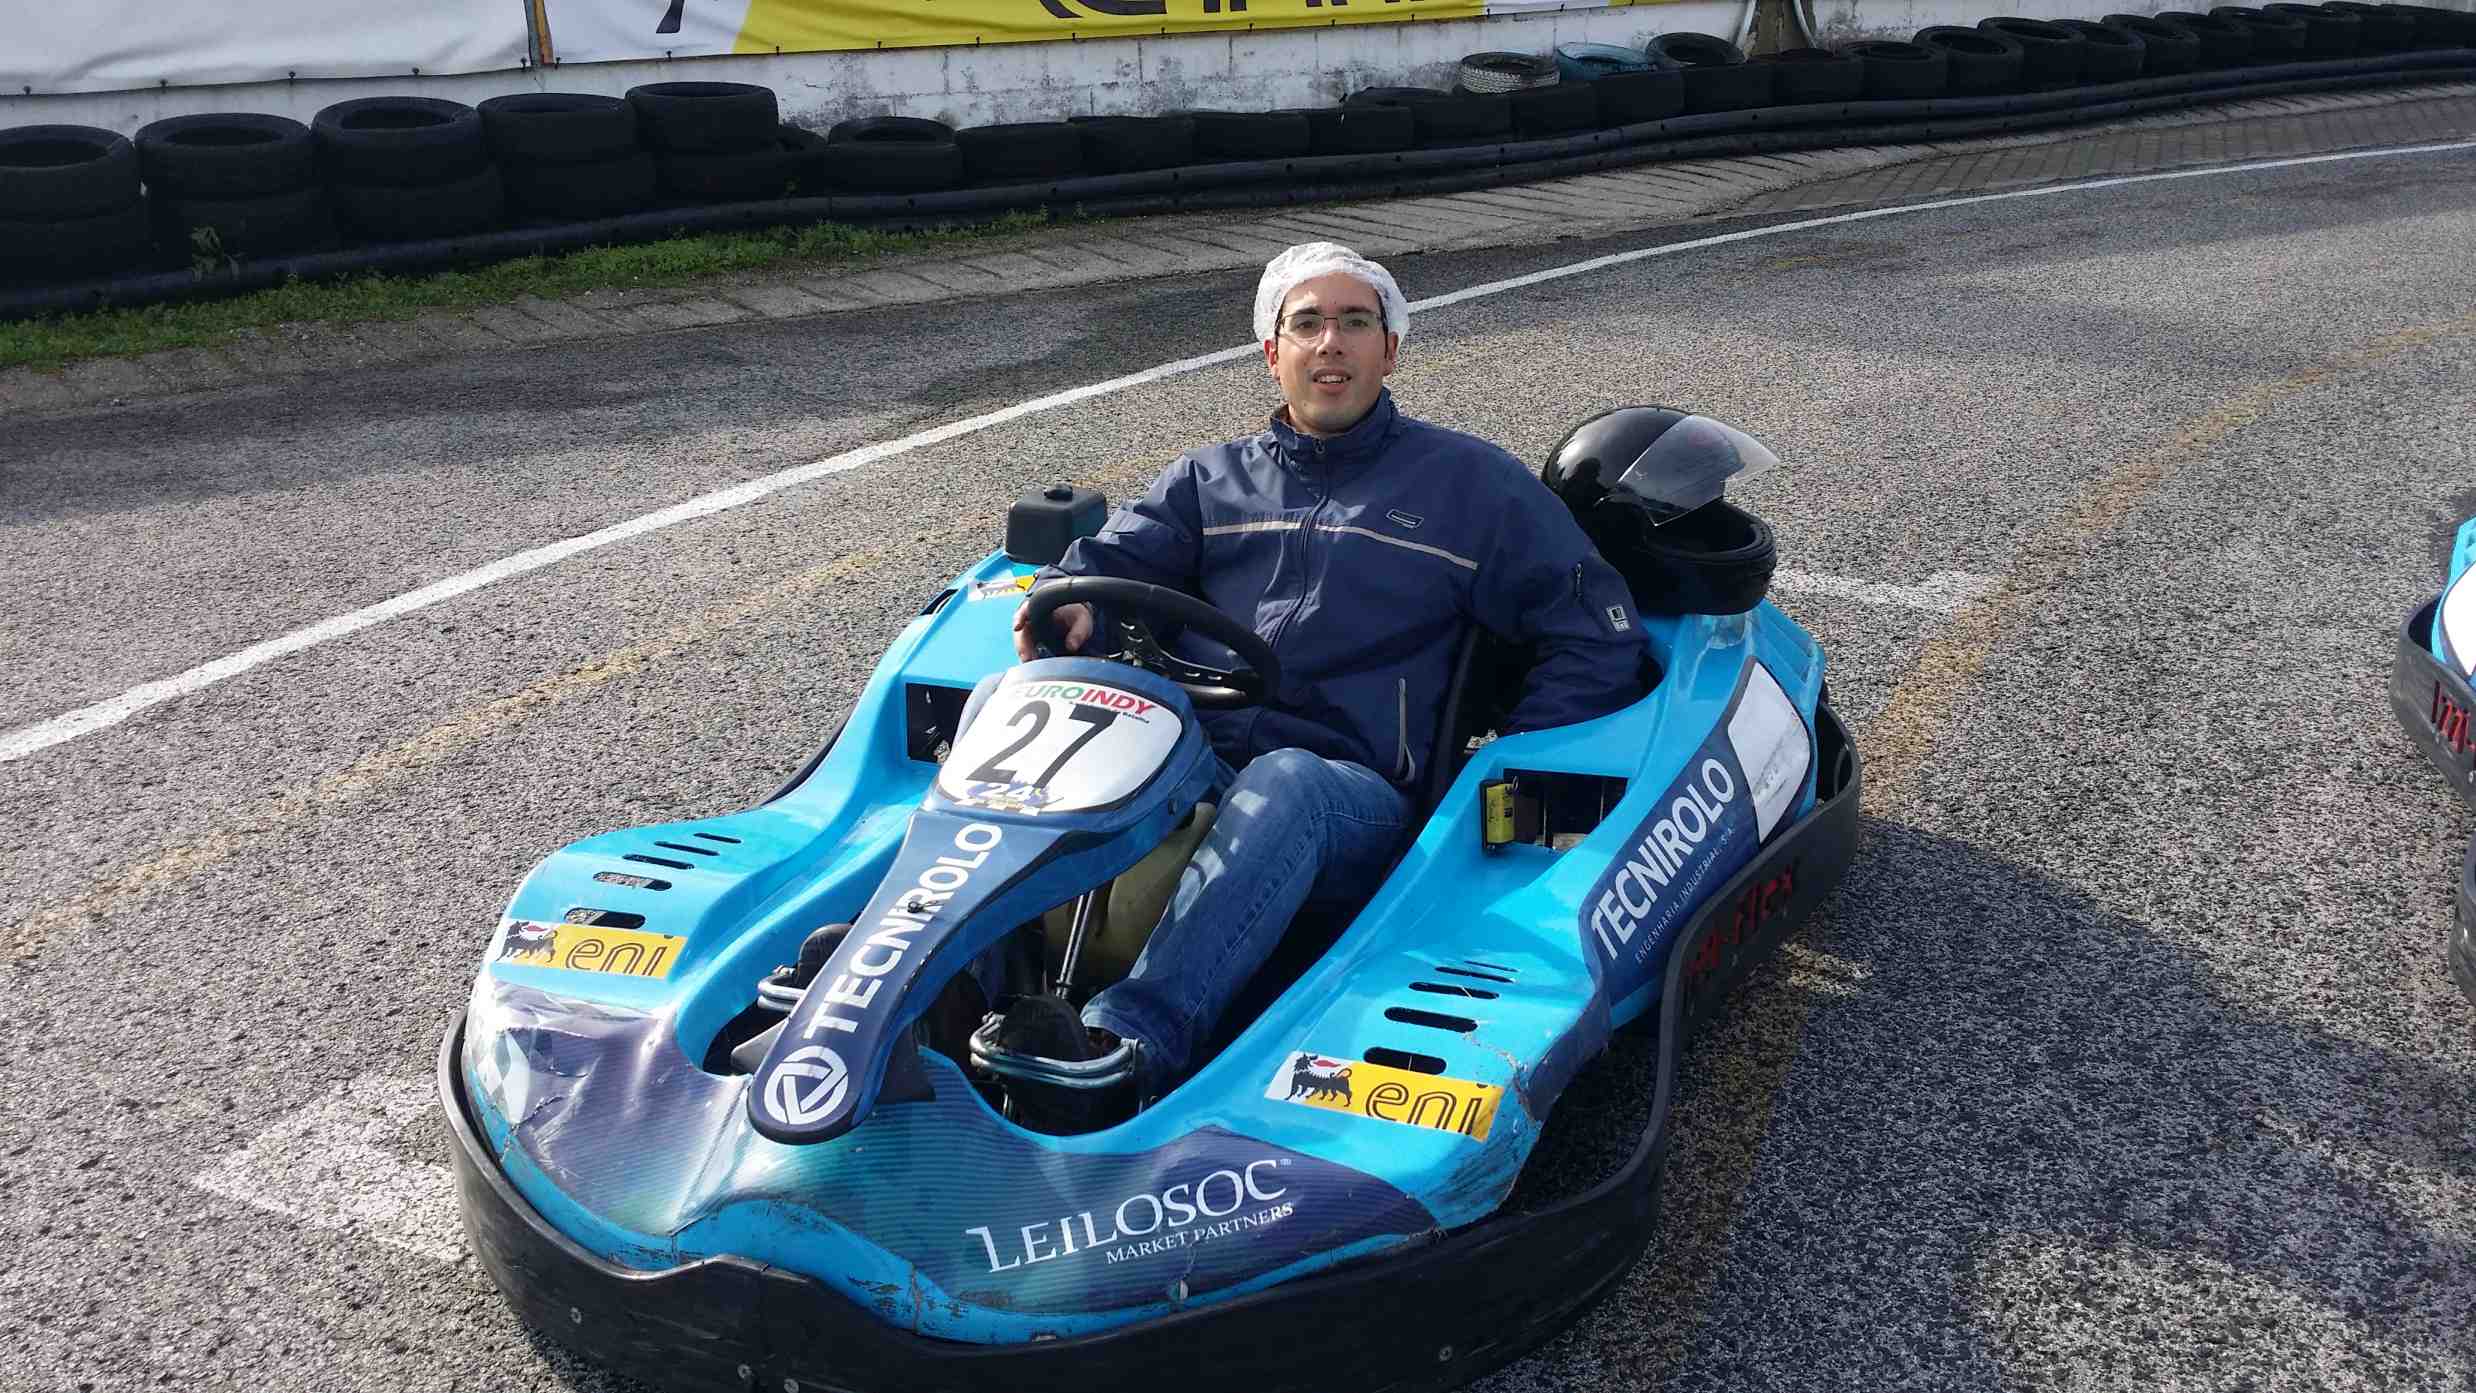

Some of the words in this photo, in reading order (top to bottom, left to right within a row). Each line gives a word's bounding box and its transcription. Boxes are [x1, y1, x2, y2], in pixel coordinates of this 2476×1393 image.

[965, 700, 1121, 789] 27
[1591, 758, 1735, 961] TECNIROLO
[565, 934, 675, 976] eni
[803, 822, 1003, 1040] TECNIROLO
[1634, 901, 1681, 964] ENGENHARIA
[1366, 1082, 1489, 1136] eni
[1105, 1231, 1190, 1265] MARKET
[1193, 1201, 1294, 1242] PARTNERS
